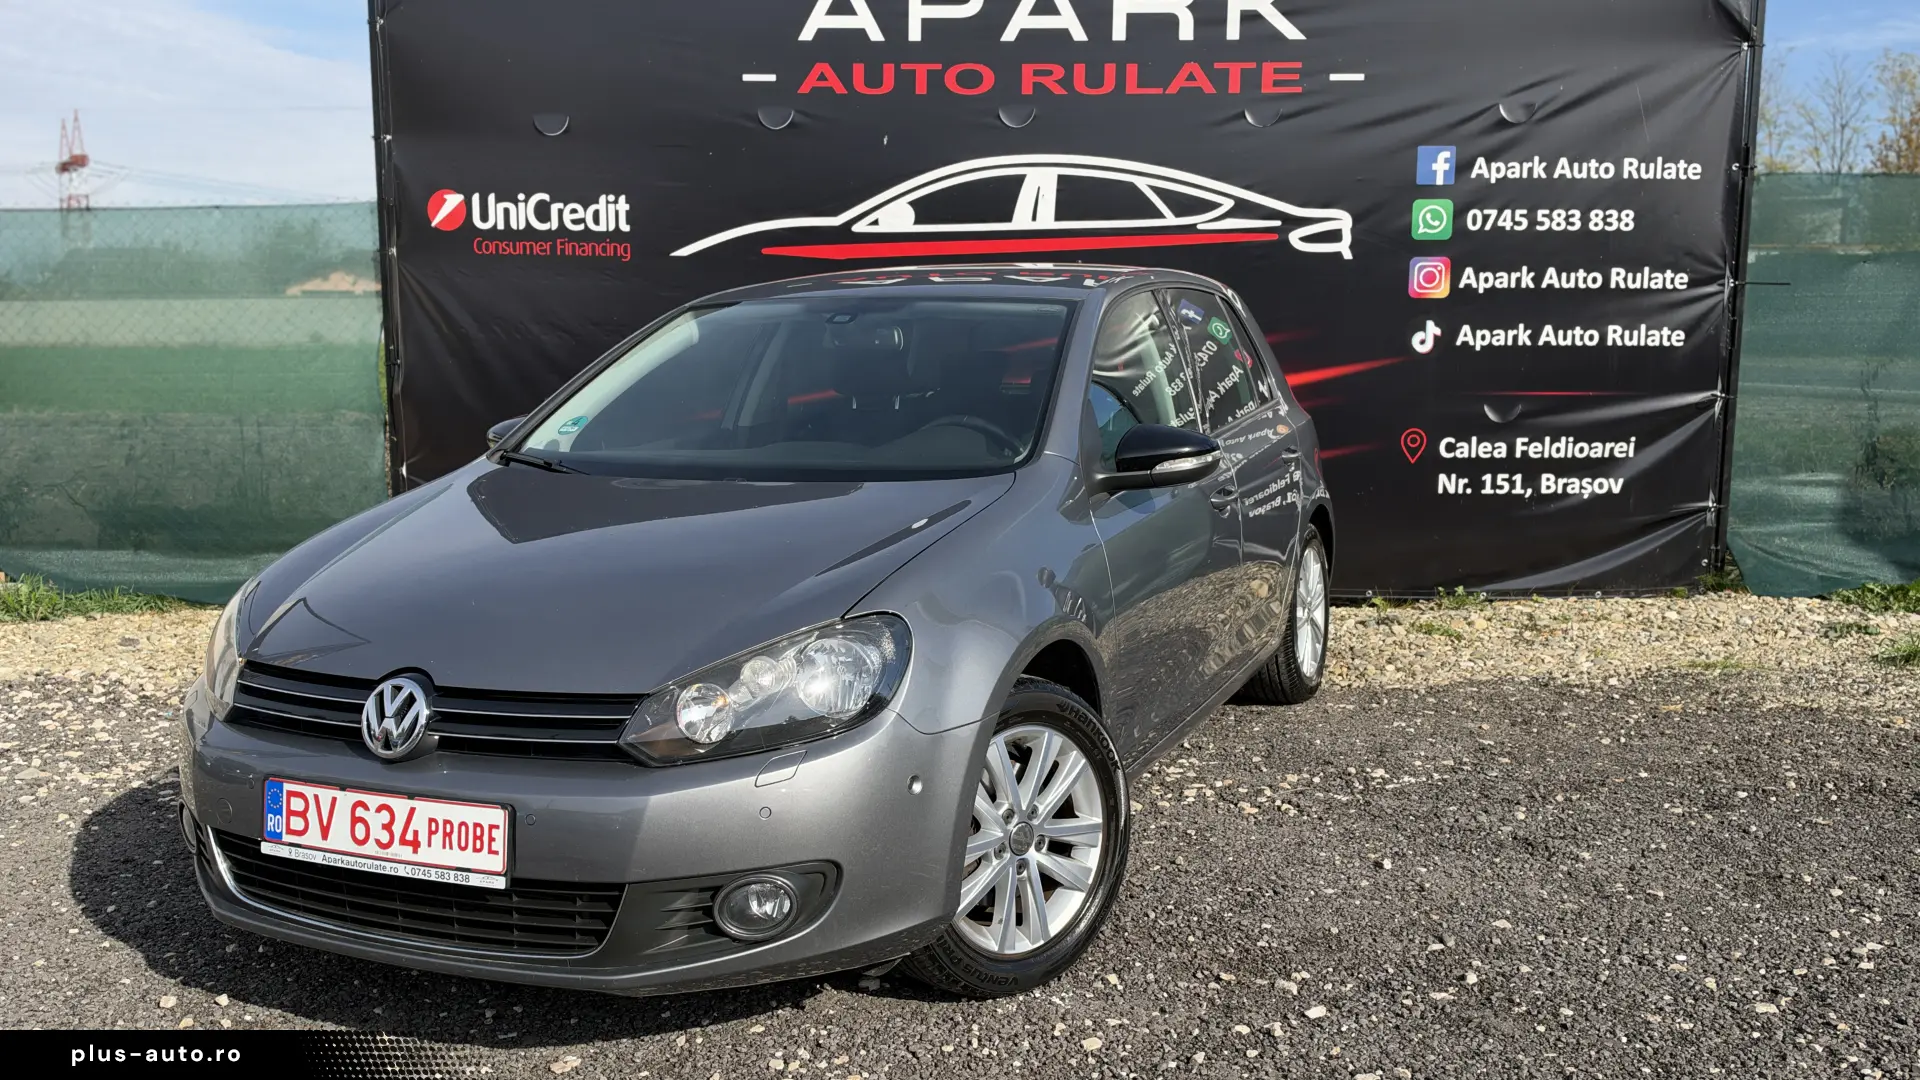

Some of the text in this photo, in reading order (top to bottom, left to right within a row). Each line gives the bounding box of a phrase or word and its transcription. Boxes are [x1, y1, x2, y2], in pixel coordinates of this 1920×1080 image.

[798, 0, 1307, 42] APARK
[797, 62, 1303, 96] AUTO RULATE
[1470, 156, 1703, 184] Apark Auto Rulate
[471, 192, 631, 233] UniCredit
[1466, 208, 1635, 232] 0745 583 838
[473, 237, 632, 262] Consumer Financing
[1458, 265, 1689, 294] Apark Auto Rulate
[1455, 323, 1686, 352] Apark Auto Rulate
[1438, 435, 1636, 459] Calea Feldioarei
[1437, 473, 1625, 500] Nr. 151, Brașov
[267, 813, 283, 833] RO
[285, 789, 500, 856] BV 634 PROBE
[321, 853, 399, 874] Aparkautorulate.ro
[411, 867, 432, 879] 0745
[434, 870, 451, 881] 583
[453, 872, 471, 884] 838
